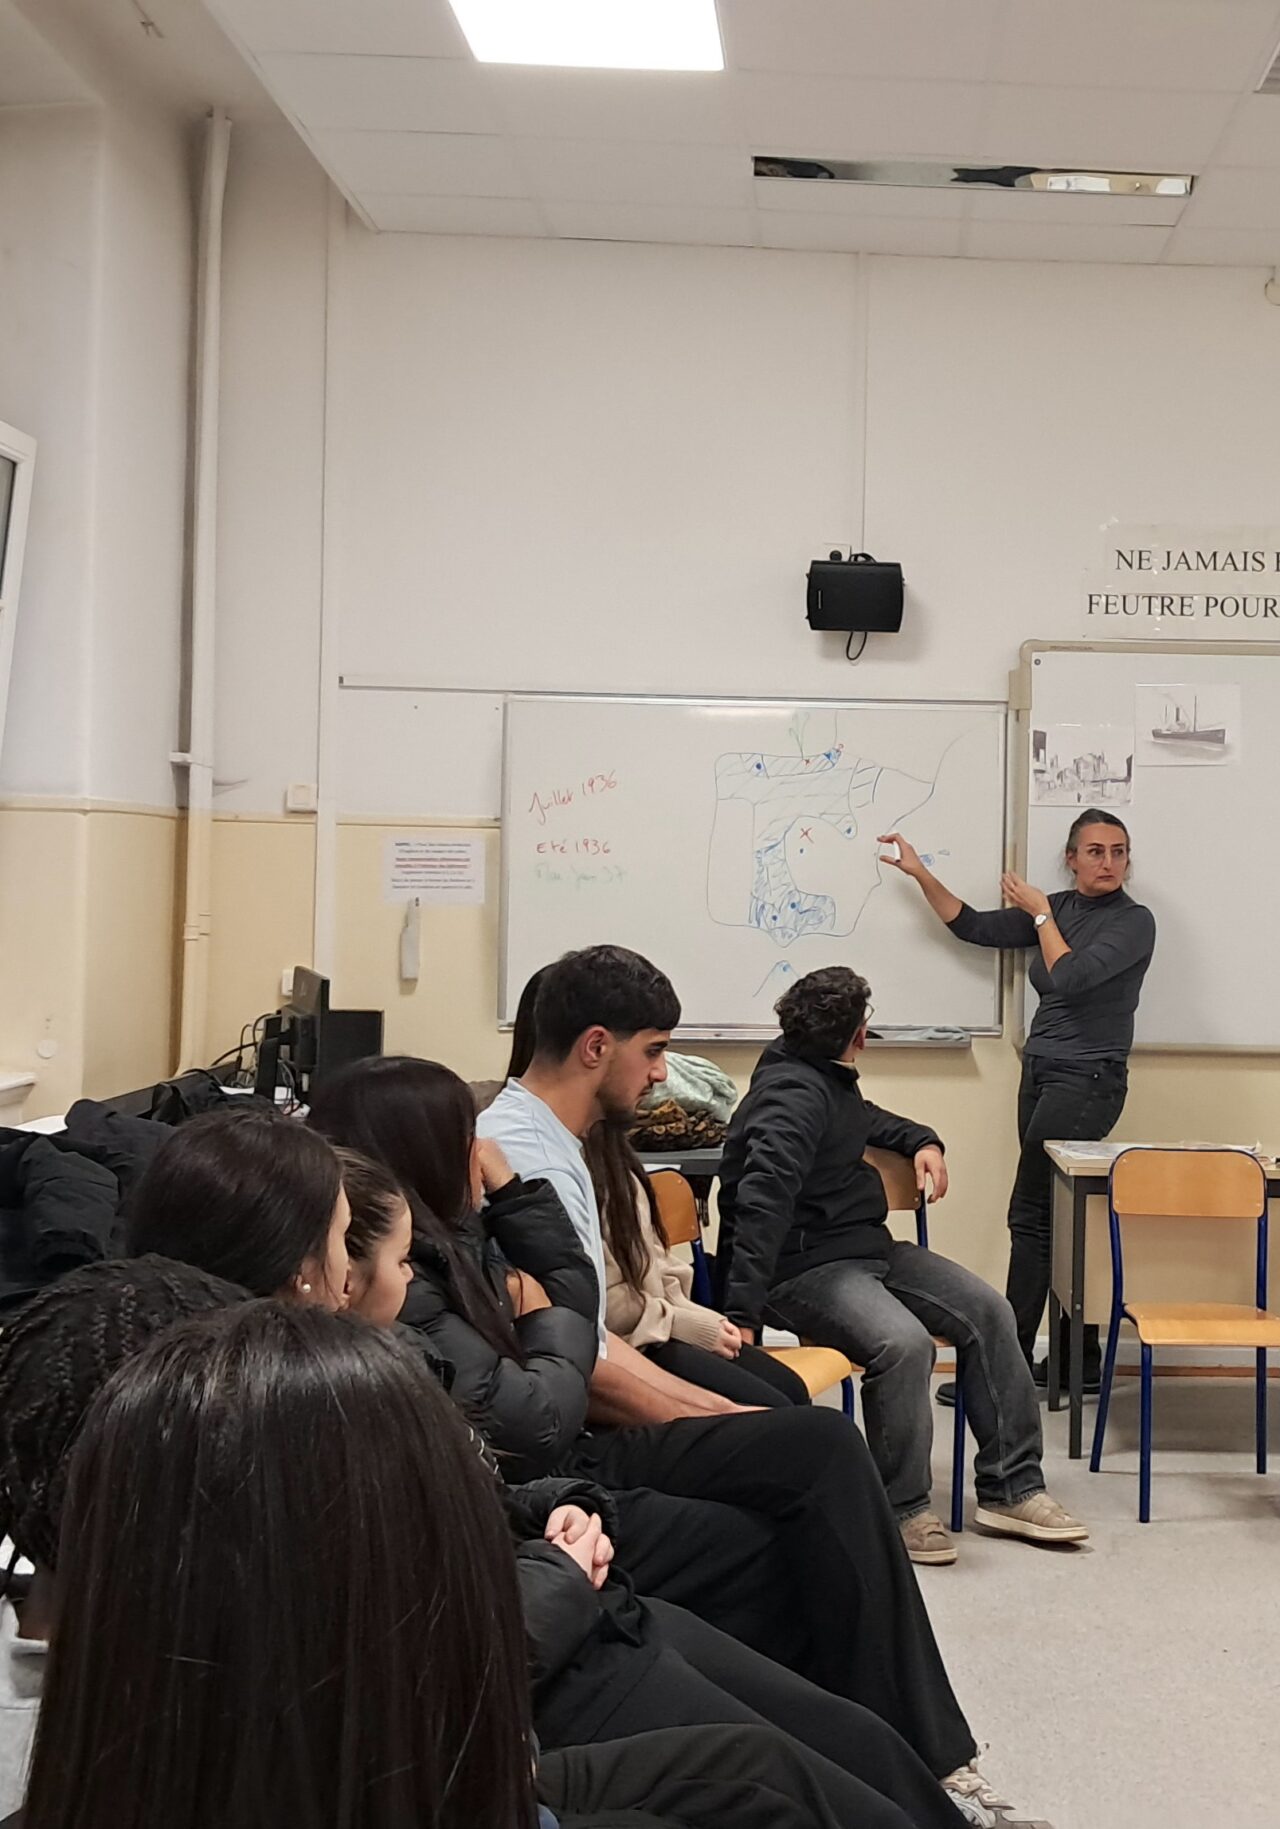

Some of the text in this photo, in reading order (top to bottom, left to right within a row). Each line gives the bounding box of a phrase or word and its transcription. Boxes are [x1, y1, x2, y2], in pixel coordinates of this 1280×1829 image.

[1115, 550, 1152, 571] NE
[1162, 550, 1266, 573] JAMAIS
[1087, 594, 1195, 616] FEUTRE
[1204, 596, 1280, 618] POUR
[581, 769, 618, 797] 1936
[575, 838, 611, 855] 1936
